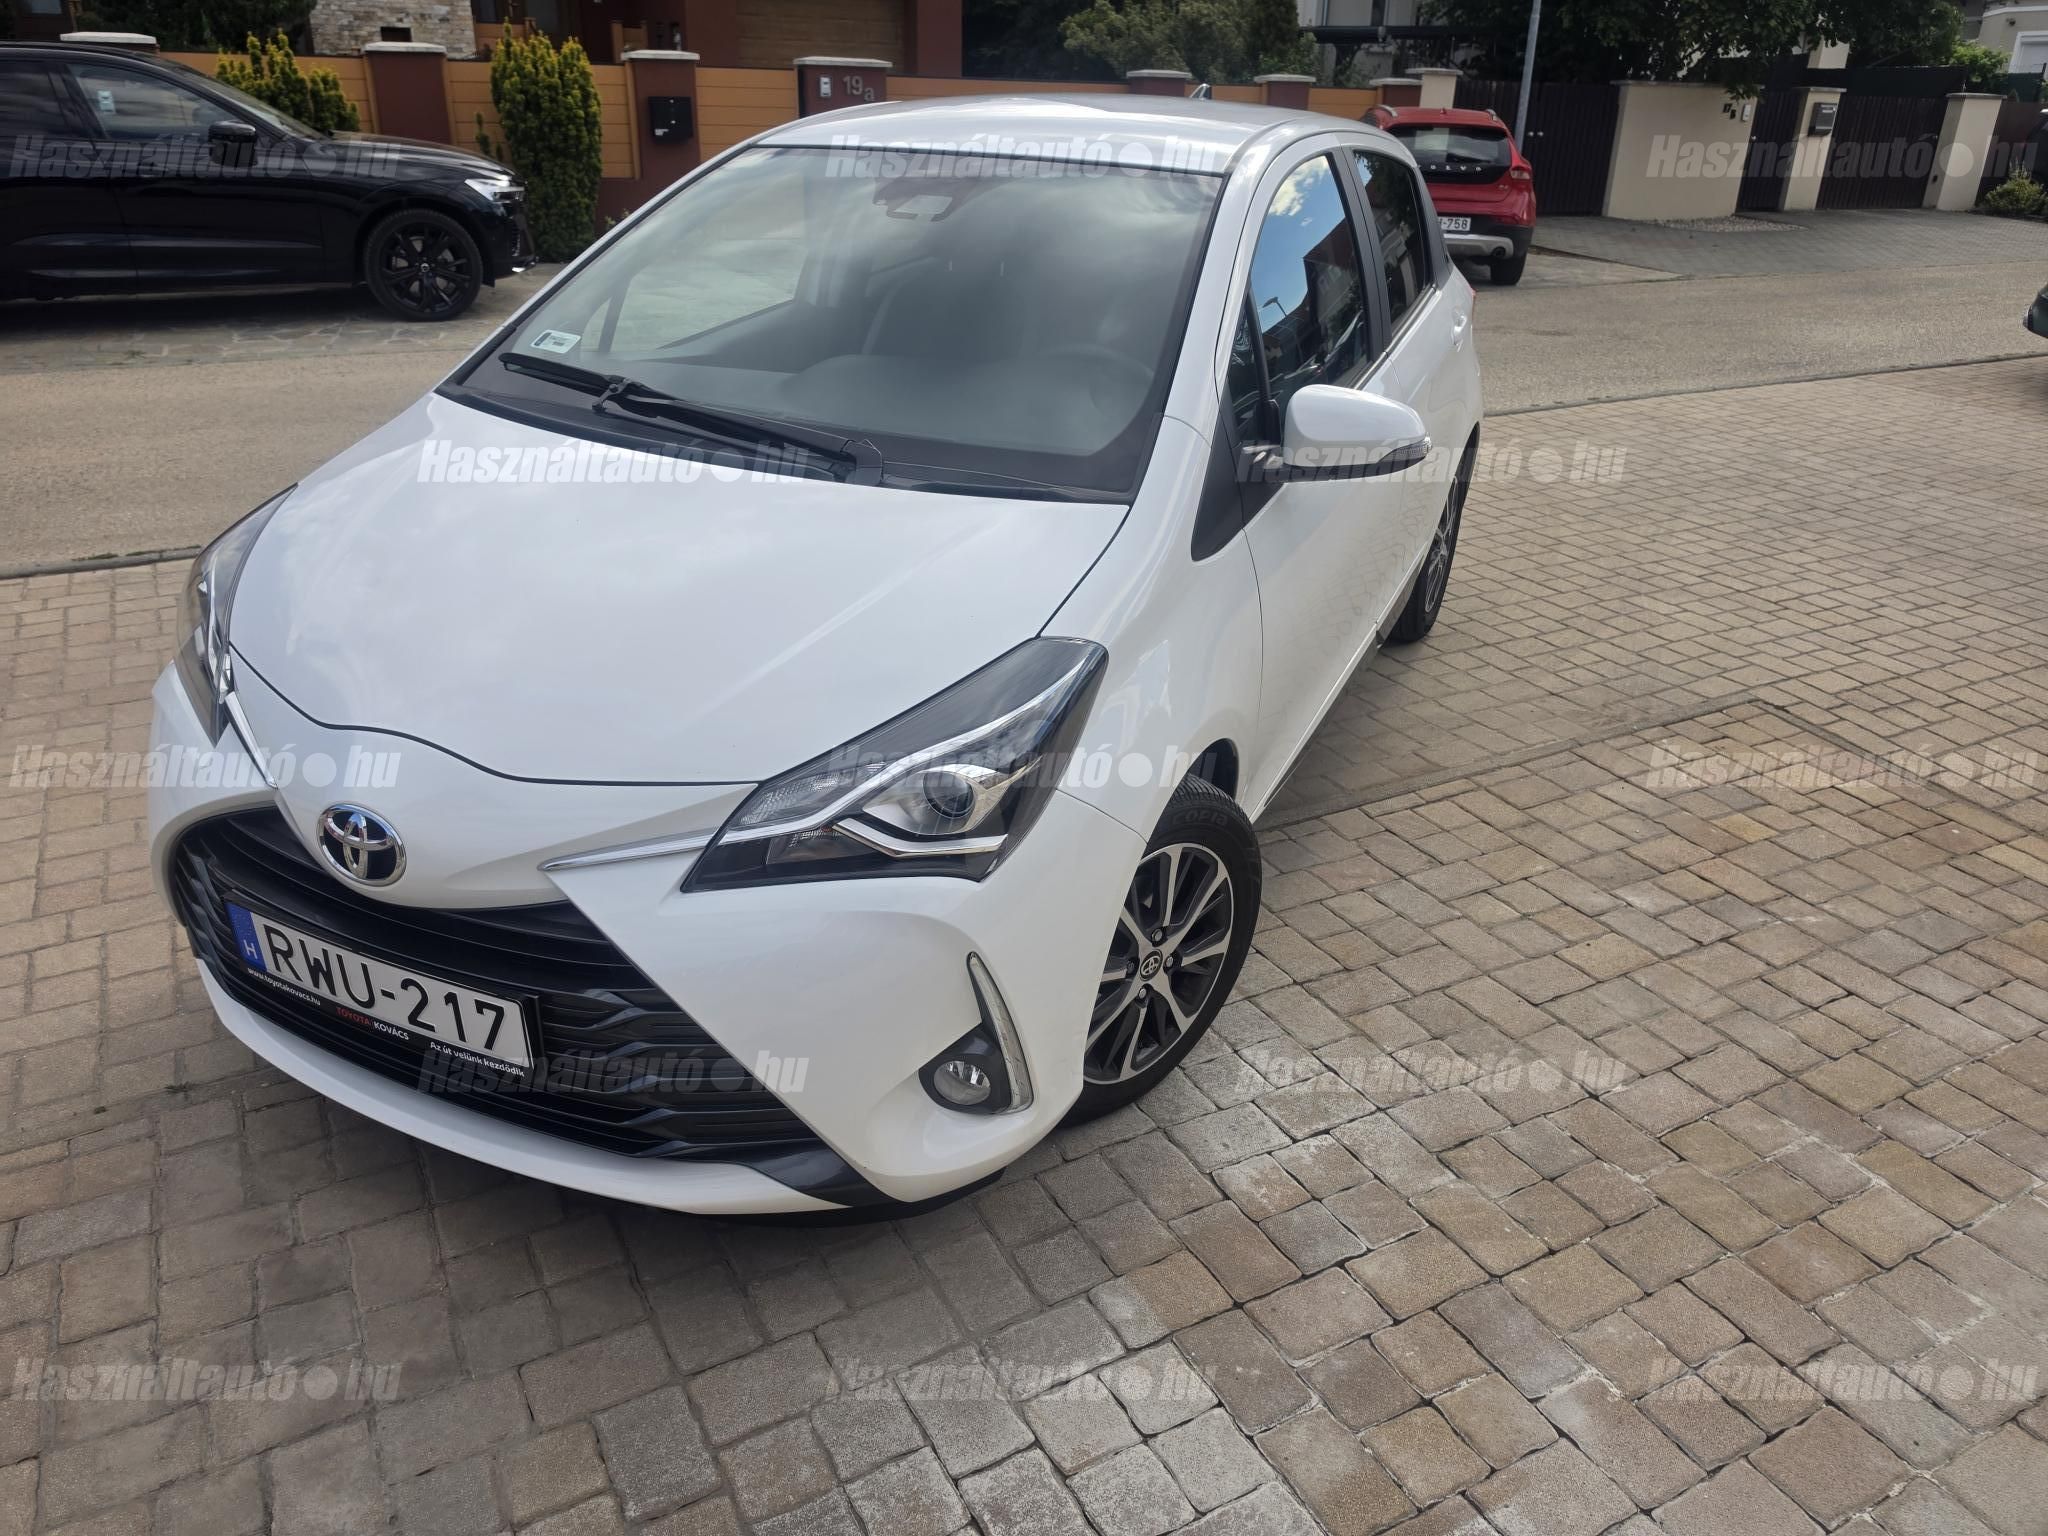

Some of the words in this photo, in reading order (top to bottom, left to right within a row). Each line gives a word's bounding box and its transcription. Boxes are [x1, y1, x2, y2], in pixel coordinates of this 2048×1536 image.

[243, 940, 258, 959] H
[248, 967, 321, 1006] www.toyotakovacs.hu
[263, 924, 505, 1050] RWU-217
[336, 1006, 371, 1026] TOYOTA
[373, 1020, 410, 1040] KOVÁCS
[430, 1041, 442, 1052] Az
[442, 1044, 453, 1056] út
[453, 1049, 482, 1065] velünk
